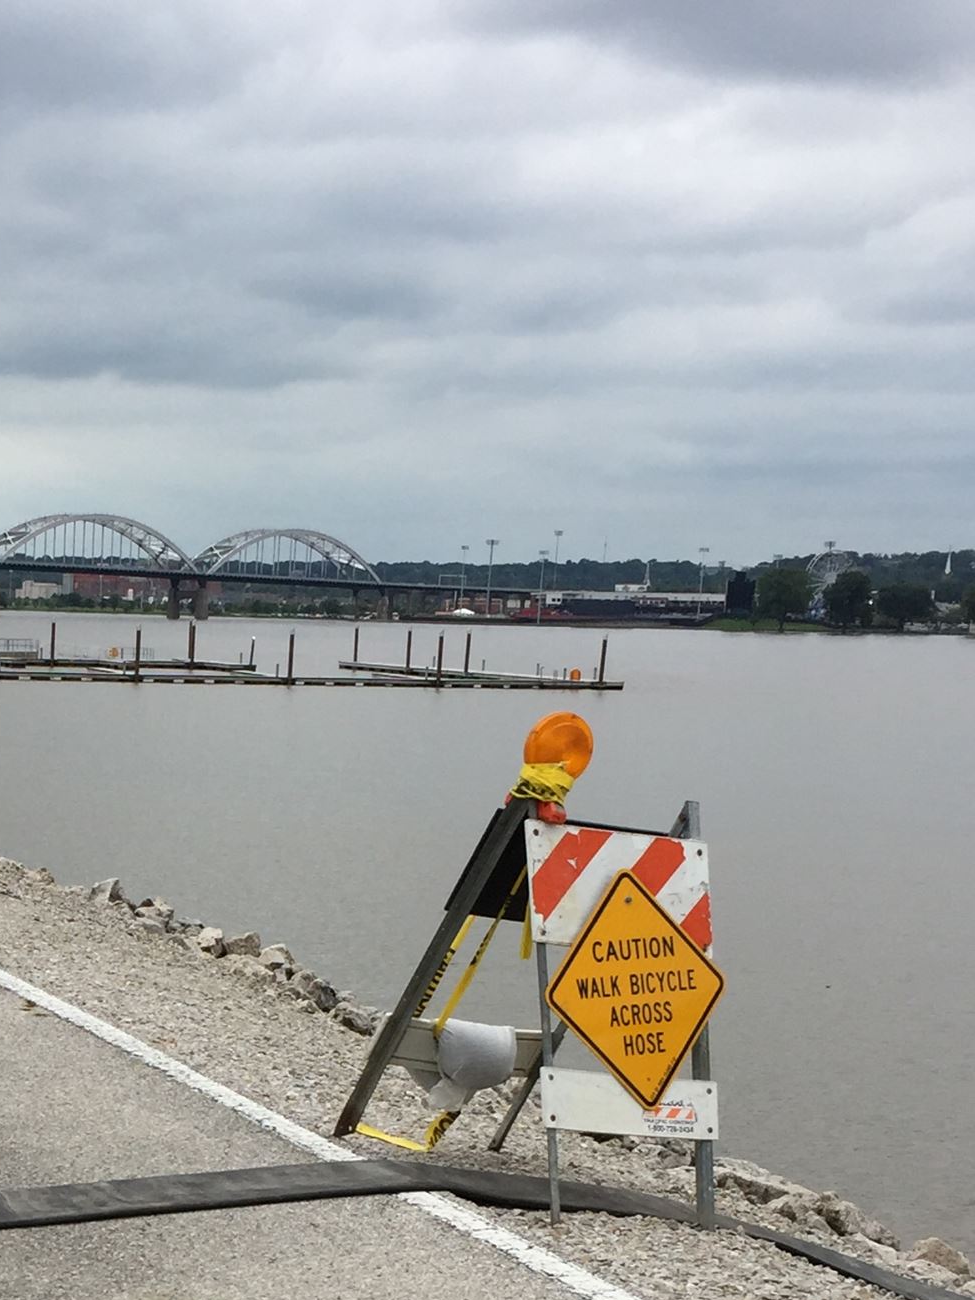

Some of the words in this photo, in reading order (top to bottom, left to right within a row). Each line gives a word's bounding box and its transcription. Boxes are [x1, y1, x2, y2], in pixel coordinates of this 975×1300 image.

[591, 936, 675, 963] CAUTION
[576, 975, 621, 999] WALK
[629, 969, 697, 995] BICYCLE
[610, 1001, 673, 1027] ACROSS
[623, 1032, 666, 1056] HOSE
